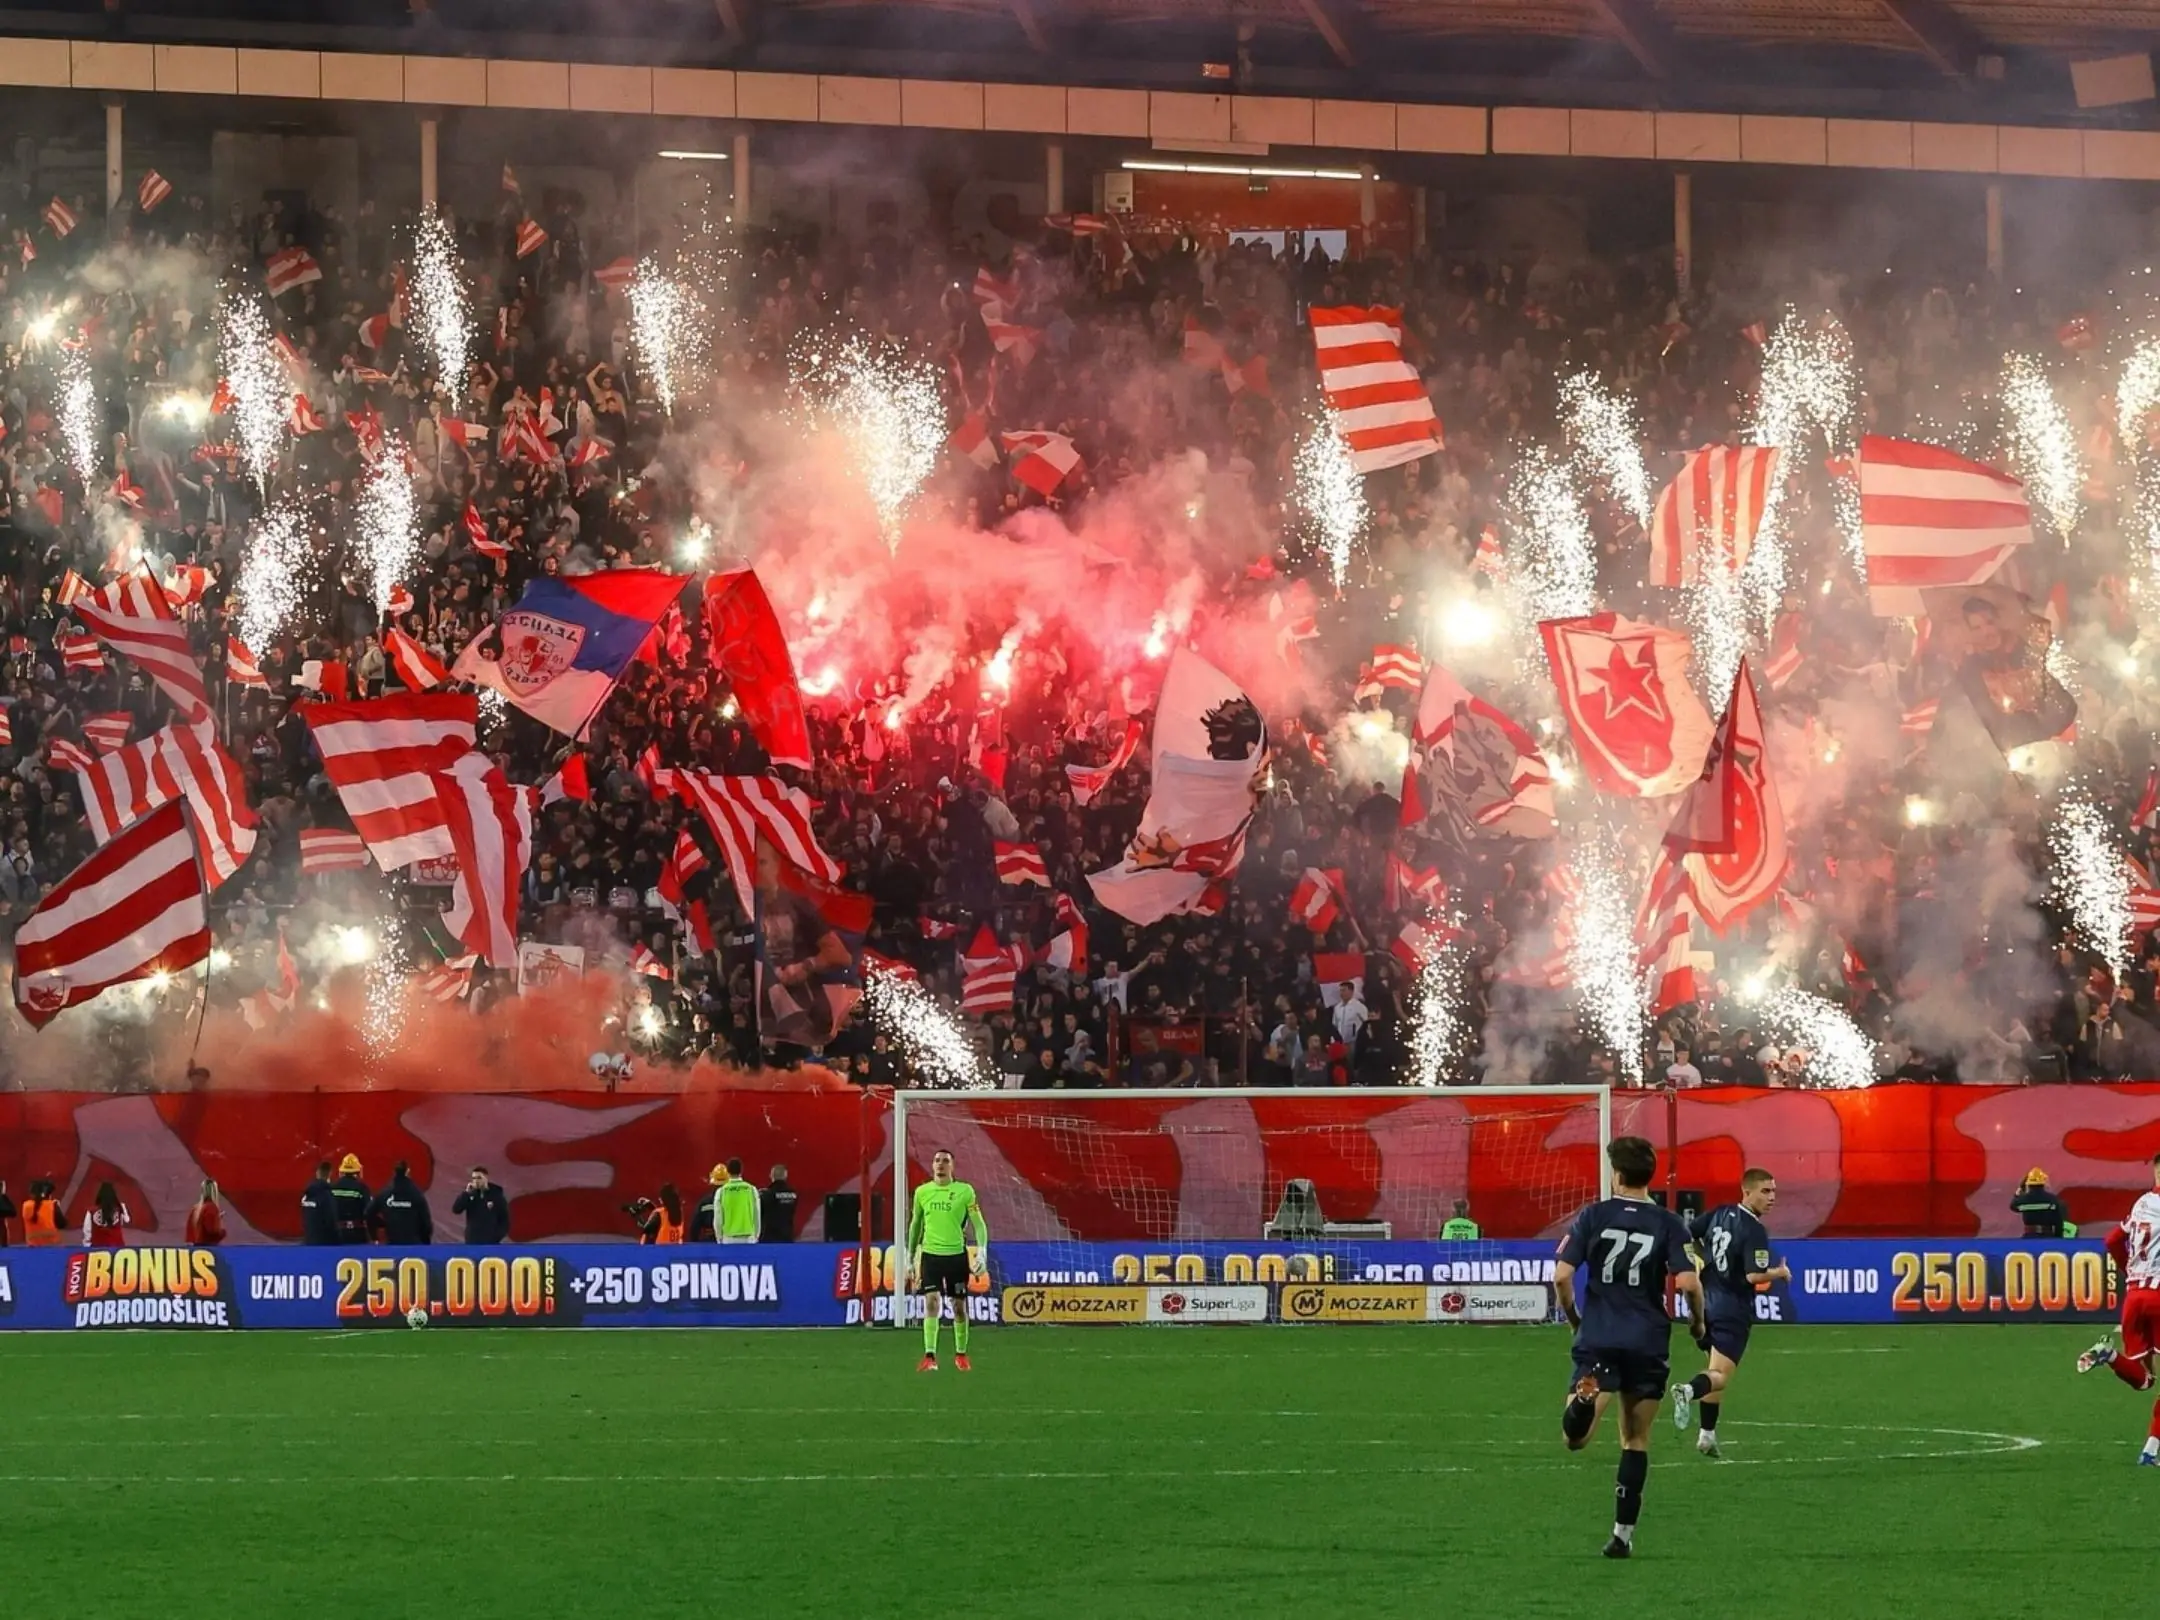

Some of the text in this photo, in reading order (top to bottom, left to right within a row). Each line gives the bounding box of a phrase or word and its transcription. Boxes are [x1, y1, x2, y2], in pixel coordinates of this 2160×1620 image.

[930, 1201, 952, 1212] mts
[84, 1248, 218, 1297] BONUS
[840, 1257, 852, 1291] NOVI
[1601, 1228, 1654, 1286] 77
[69, 1261, 82, 1295] NOVI
[251, 1257, 541, 1317] UZMI DO 250.000
[570, 1263, 777, 1304] +250 SPINOVA
[1805, 1251, 2103, 1312] UZMI DO 250.000
[75, 1294, 229, 1327] DOBRODOŠLICE
[1051, 1299, 1138, 1312] MOZZART
[1191, 1299, 1255, 1312] SuperLiga
[1330, 1298, 1418, 1310] MOZZART
[1471, 1299, 1535, 1311] SuperLiga
